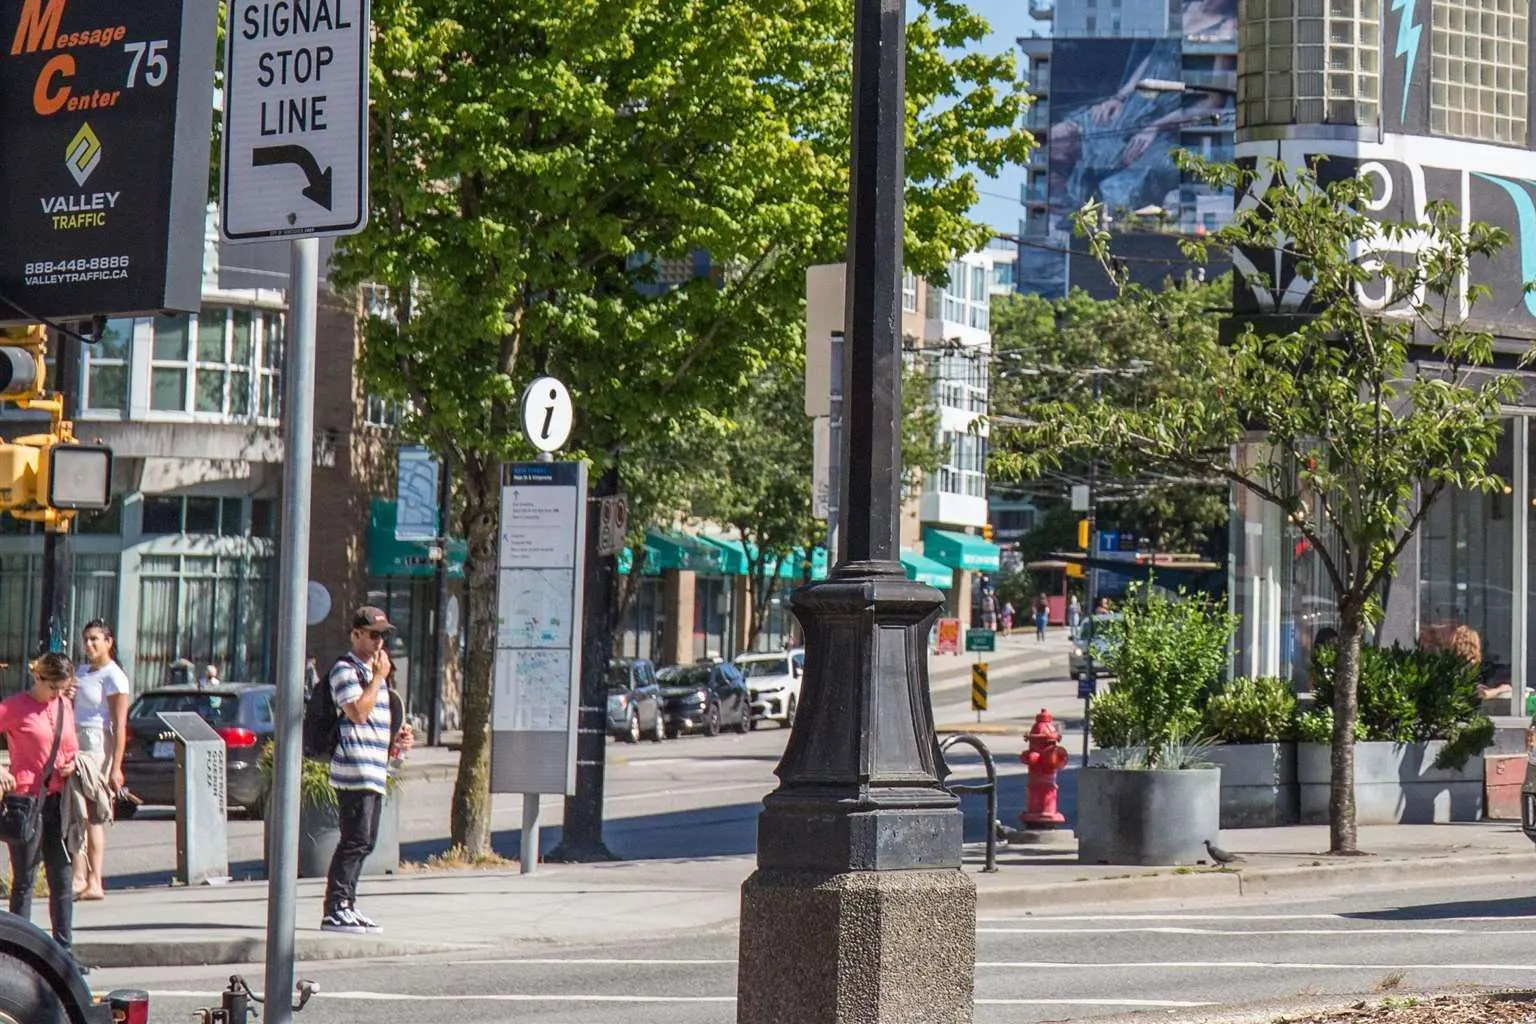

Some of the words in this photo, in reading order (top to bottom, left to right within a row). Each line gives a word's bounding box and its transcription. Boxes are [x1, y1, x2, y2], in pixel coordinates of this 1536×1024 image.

[124, 40, 168, 88] 75
[257, 46, 333, 88] STOP
[33, 53, 120, 116] Center
[261, 95, 327, 136] LINE
[40, 191, 120, 214] VALLEY
[52, 212, 106, 230] TRAFFIC
[25, 256, 130, 275] 888-448-8886
[25, 270, 128, 285] VALLEYTRAFFIC.CA
